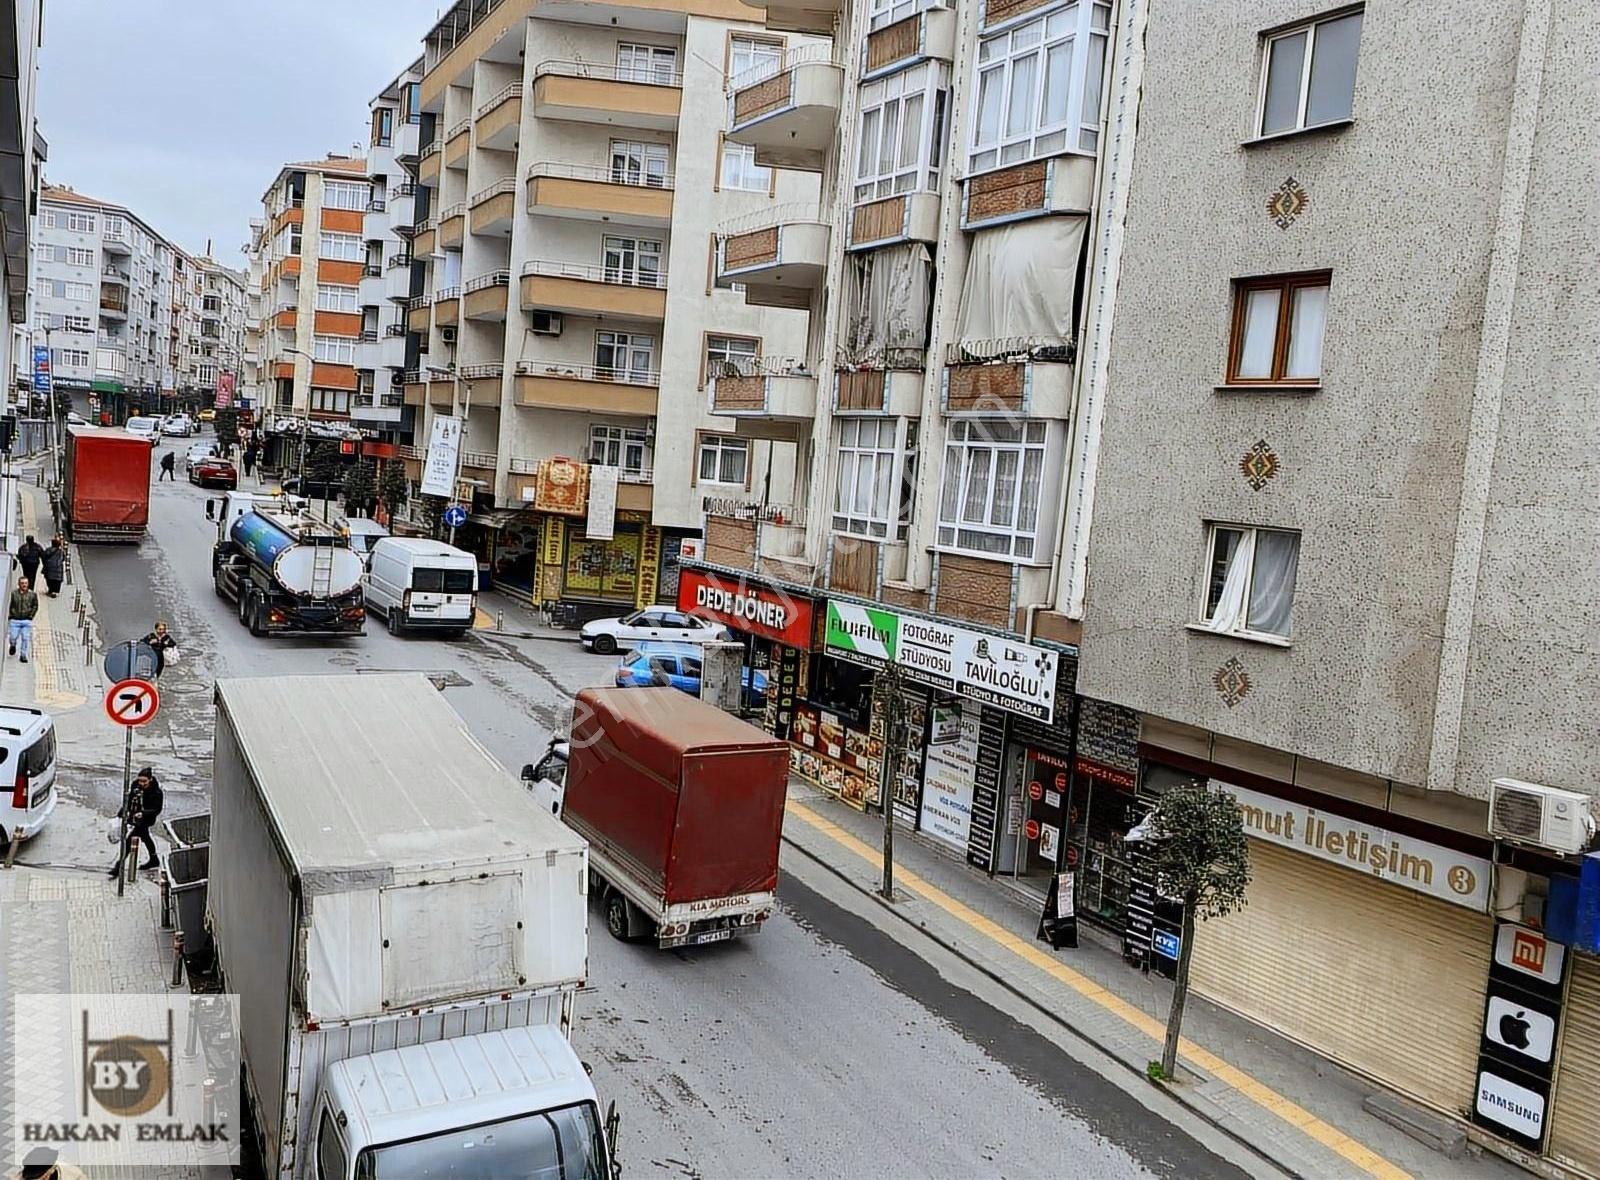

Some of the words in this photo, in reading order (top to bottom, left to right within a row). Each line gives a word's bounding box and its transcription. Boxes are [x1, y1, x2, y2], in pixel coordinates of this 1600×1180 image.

[696, 584, 732, 613] DEDE
[734, 590, 785, 629] DÖNER
[831, 617, 890, 645] FUJIFILM
[902, 623, 955, 648] FOTOĞRAF
[901, 648, 952, 673] STÜDYOSU
[965, 661, 1040, 697] TAVİLOĞLU
[962, 684, 992, 702] STÜDYO
[1000, 696, 1043, 717] FOTOĞRAF
[1238, 803, 1296, 840] mut
[1304, 810, 1434, 886] İletişim
[689, 902, 707, 912] KIA
[709, 896, 750, 909] MOTORS
[1481, 1089, 1541, 1124] SAMSUNG
